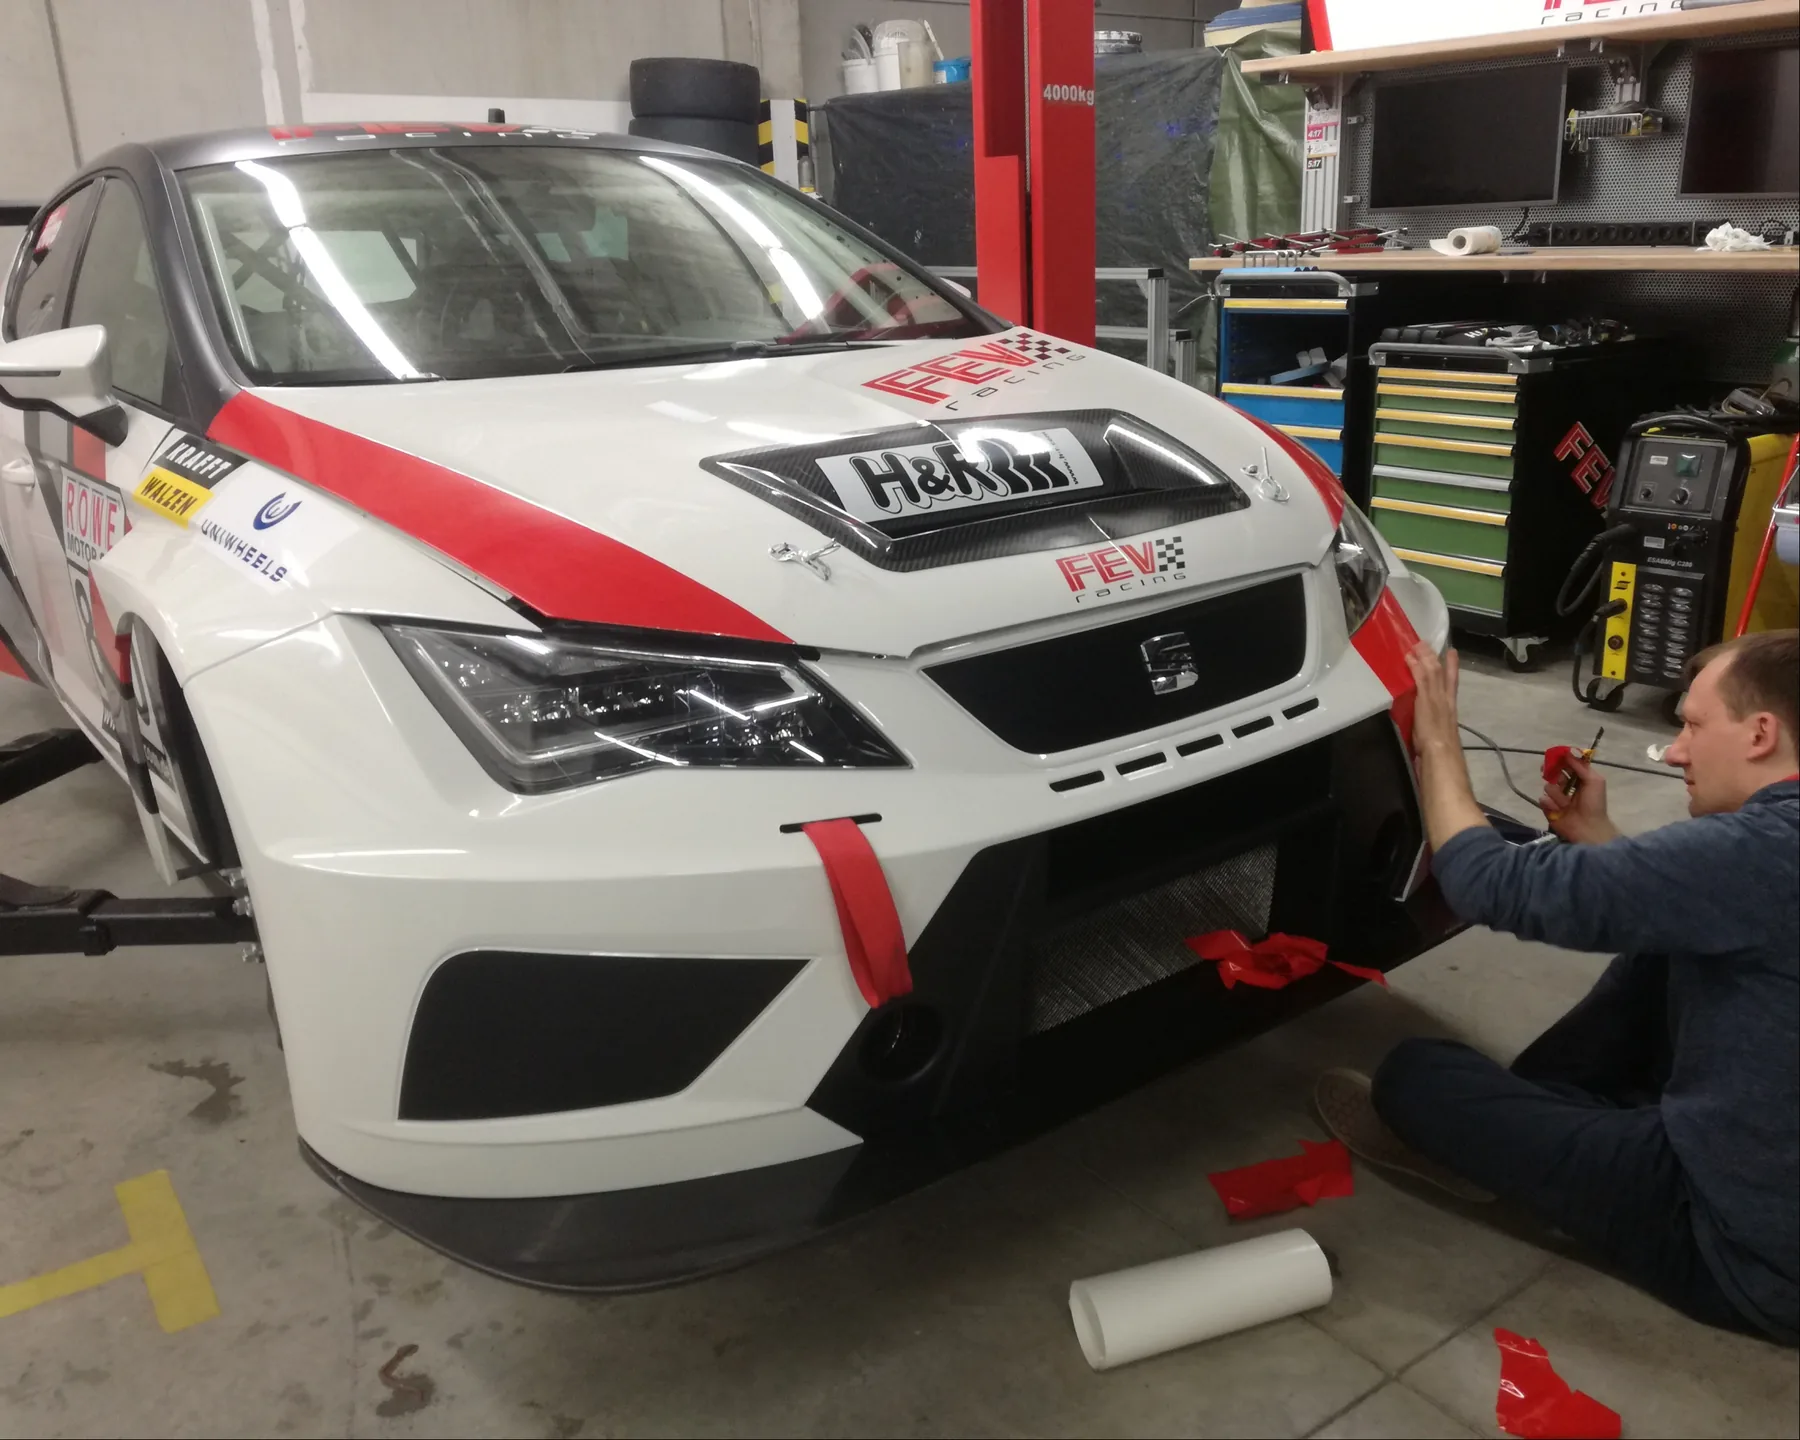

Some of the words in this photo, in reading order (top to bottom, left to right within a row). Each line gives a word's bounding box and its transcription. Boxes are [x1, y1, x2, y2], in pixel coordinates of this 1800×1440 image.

[1043, 83, 1095, 106] 4000kg
[860, 342, 1038, 405] FEV
[945, 354, 1086, 411] racing
[166, 442, 232, 479] KRAFFT
[67, 481, 118, 553] ROWE
[141, 476, 198, 516] WALZEN
[201, 519, 288, 582] UNIWHEELS
[1055, 541, 1156, 592] FEV
[1075, 572, 1187, 604] racing
